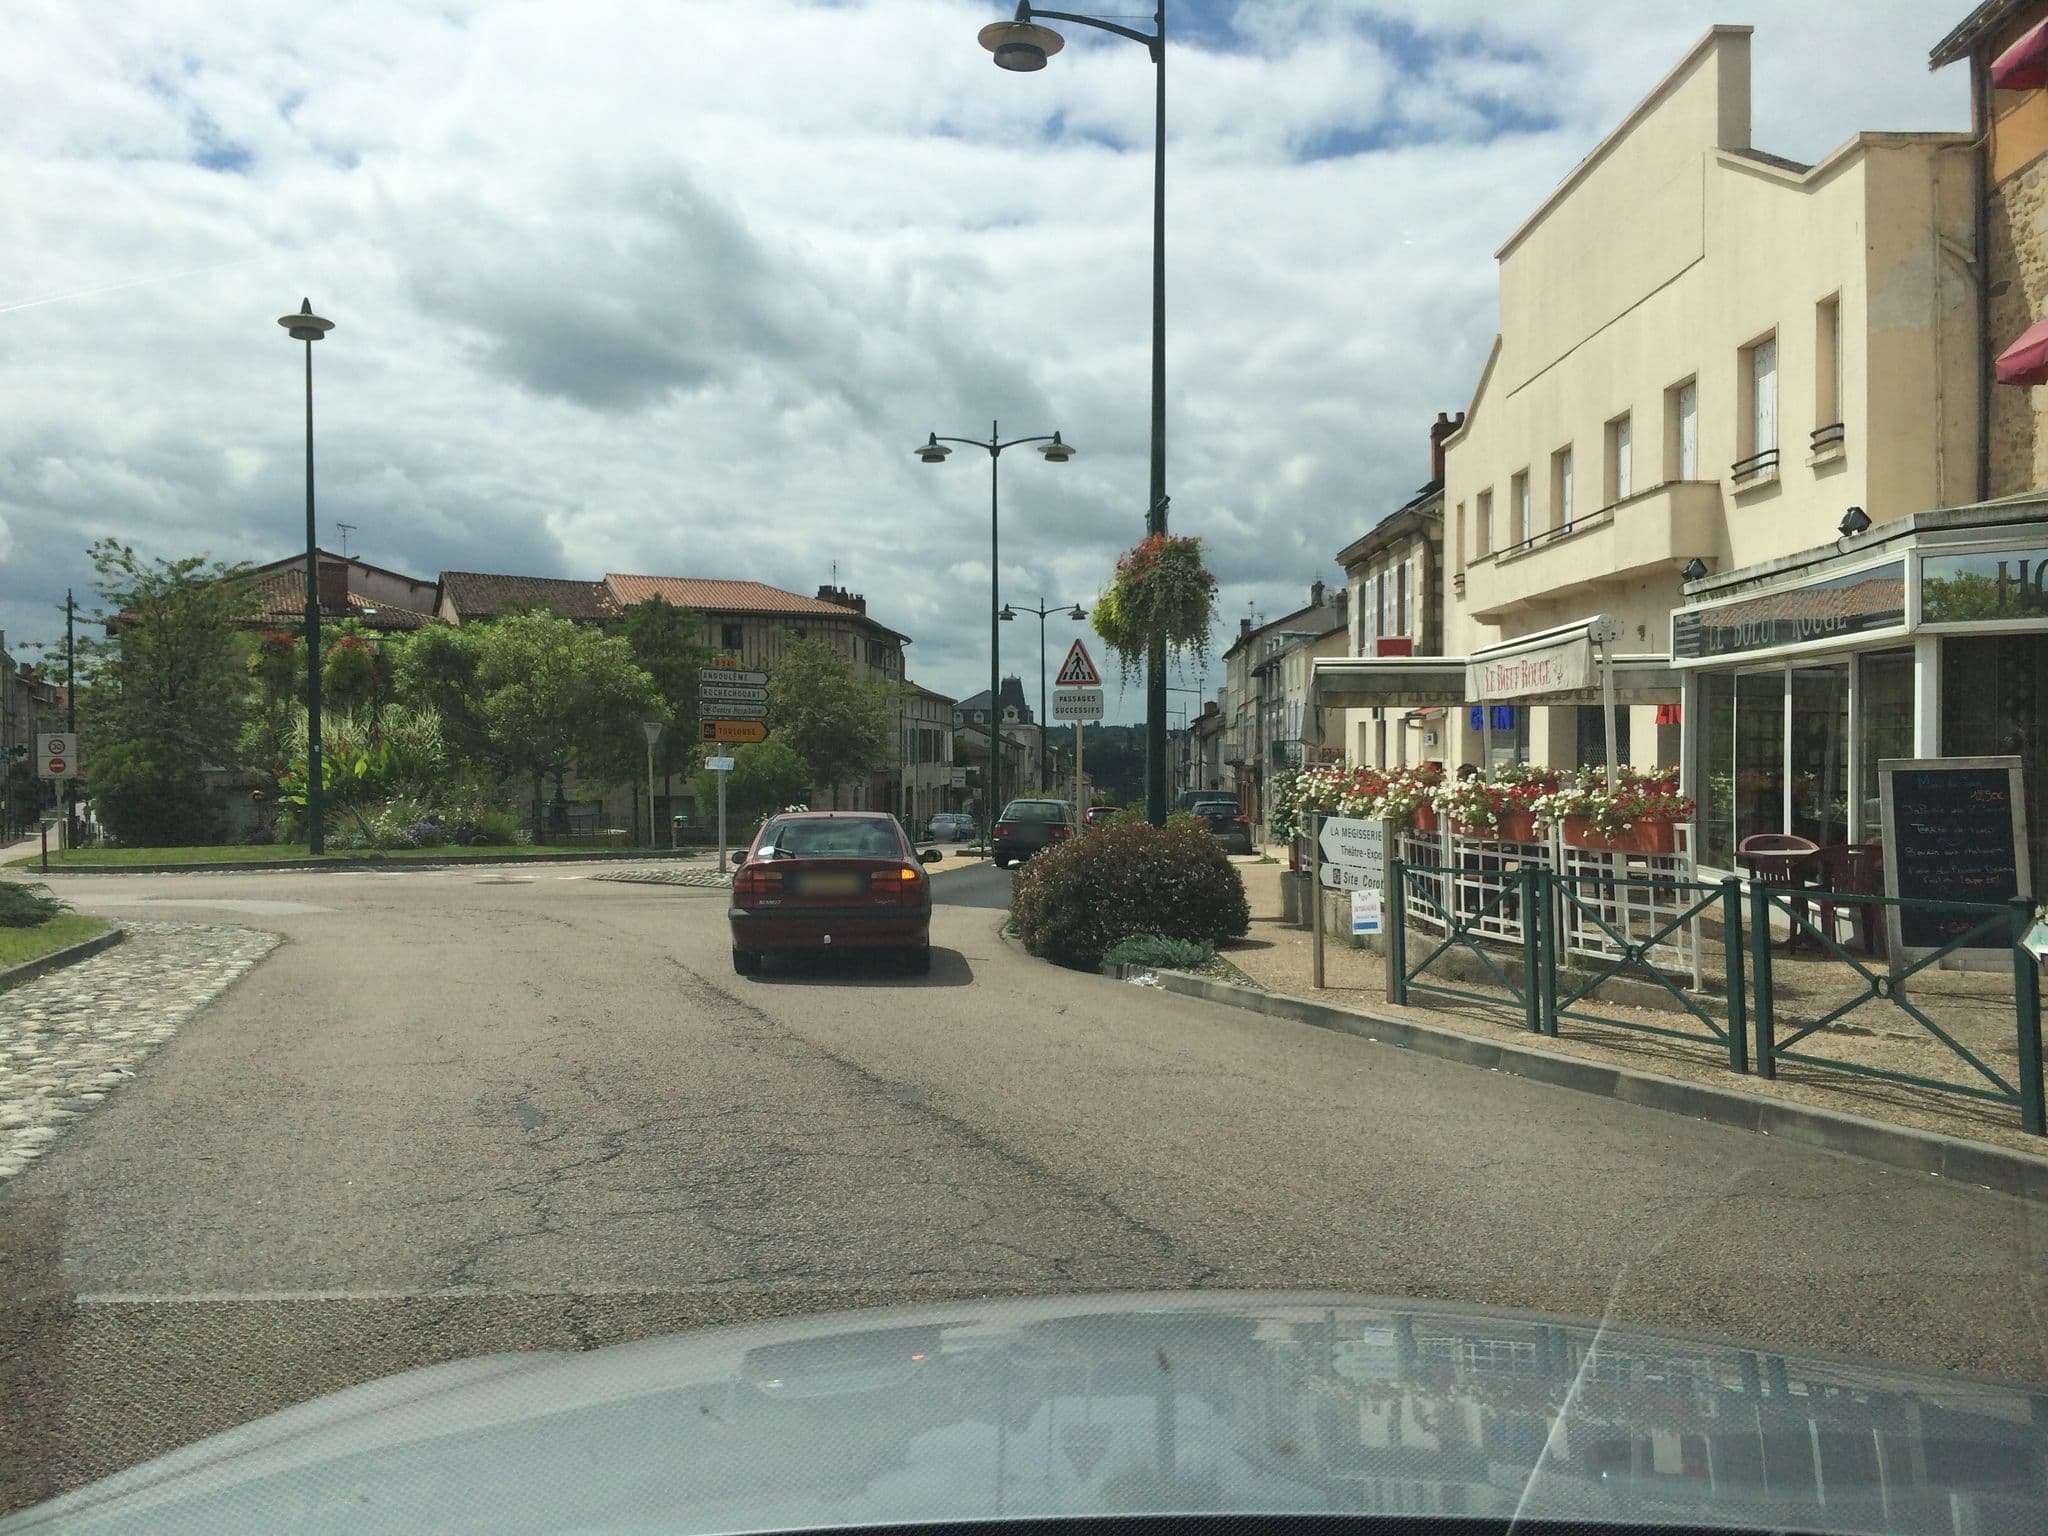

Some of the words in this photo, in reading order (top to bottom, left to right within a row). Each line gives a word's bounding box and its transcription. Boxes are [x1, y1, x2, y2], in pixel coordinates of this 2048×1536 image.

[703, 687, 761, 699] ROCHECHOUART
[1055, 706, 1100, 714] SUCCESSIFS
[52, 742, 63, 751] 30
[1330, 826, 1340, 837] LA
[1343, 871, 1359, 886] Site
[1362, 874, 1384, 890] Corot
